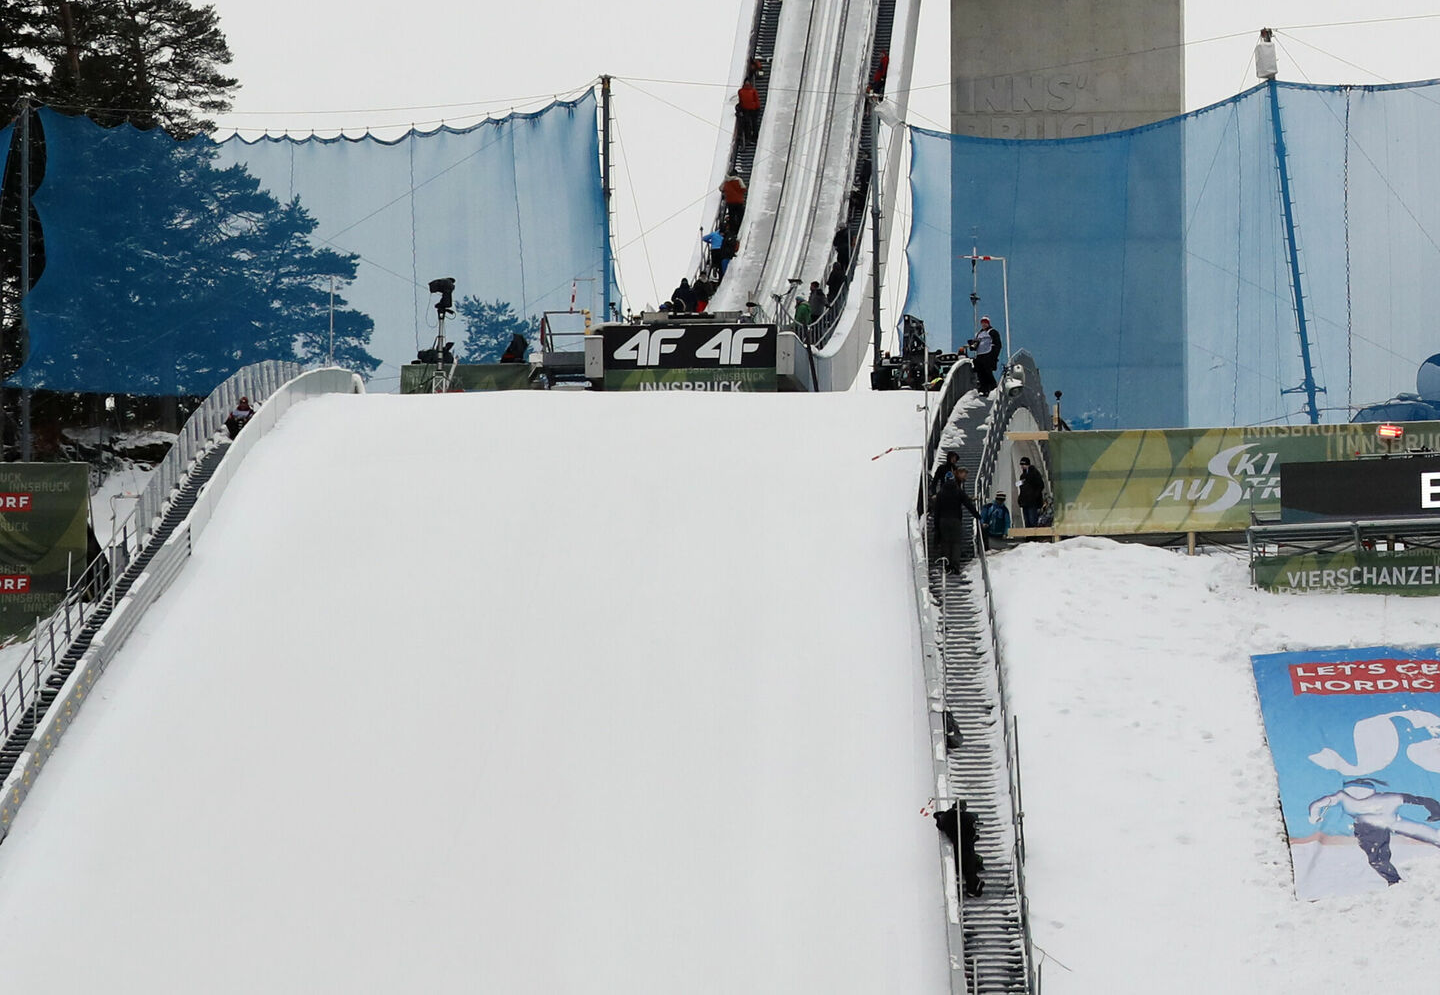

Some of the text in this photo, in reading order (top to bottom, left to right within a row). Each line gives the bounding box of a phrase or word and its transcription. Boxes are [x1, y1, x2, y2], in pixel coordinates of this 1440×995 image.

[613, 328, 768, 366] 4F 4F
[0, 578, 27, 590] RF
[1296, 662, 1386, 677] LET'S
[1299, 676, 1435, 692] NORDIC
